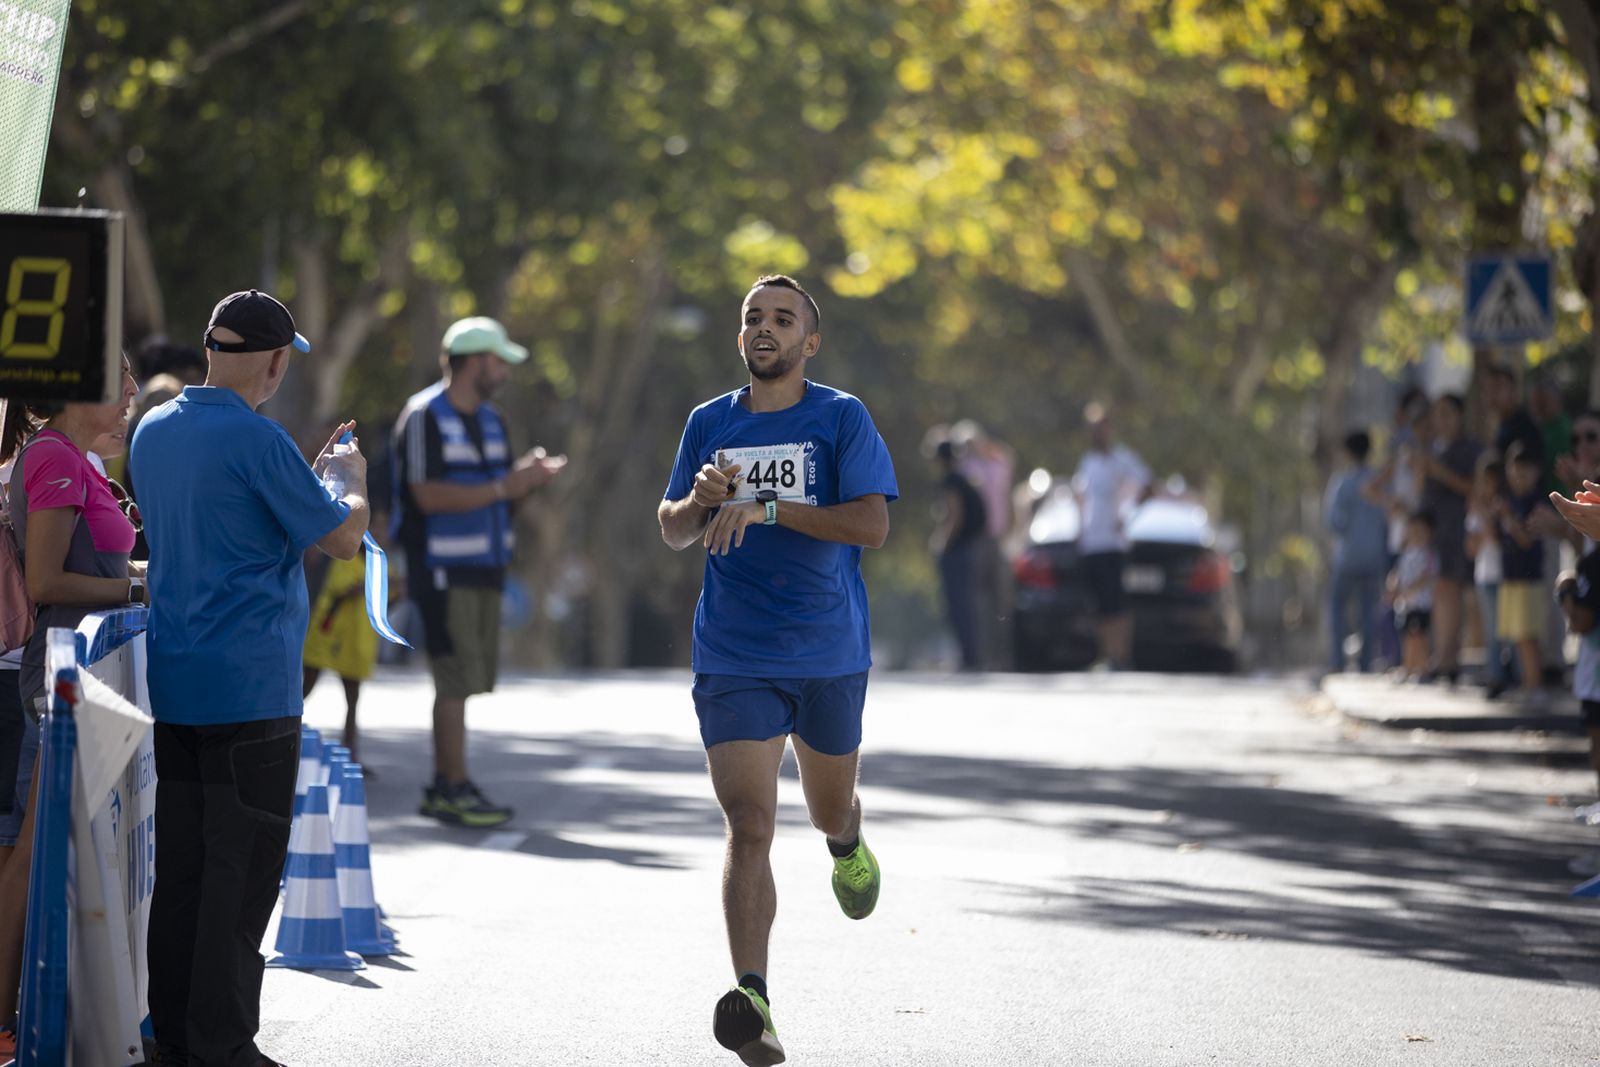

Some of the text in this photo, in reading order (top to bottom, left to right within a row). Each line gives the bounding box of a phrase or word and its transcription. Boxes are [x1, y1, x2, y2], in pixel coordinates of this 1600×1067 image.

[0, 257, 72, 359] 8
[746, 459, 796, 489] 448
[808, 461, 816, 485] 2023
